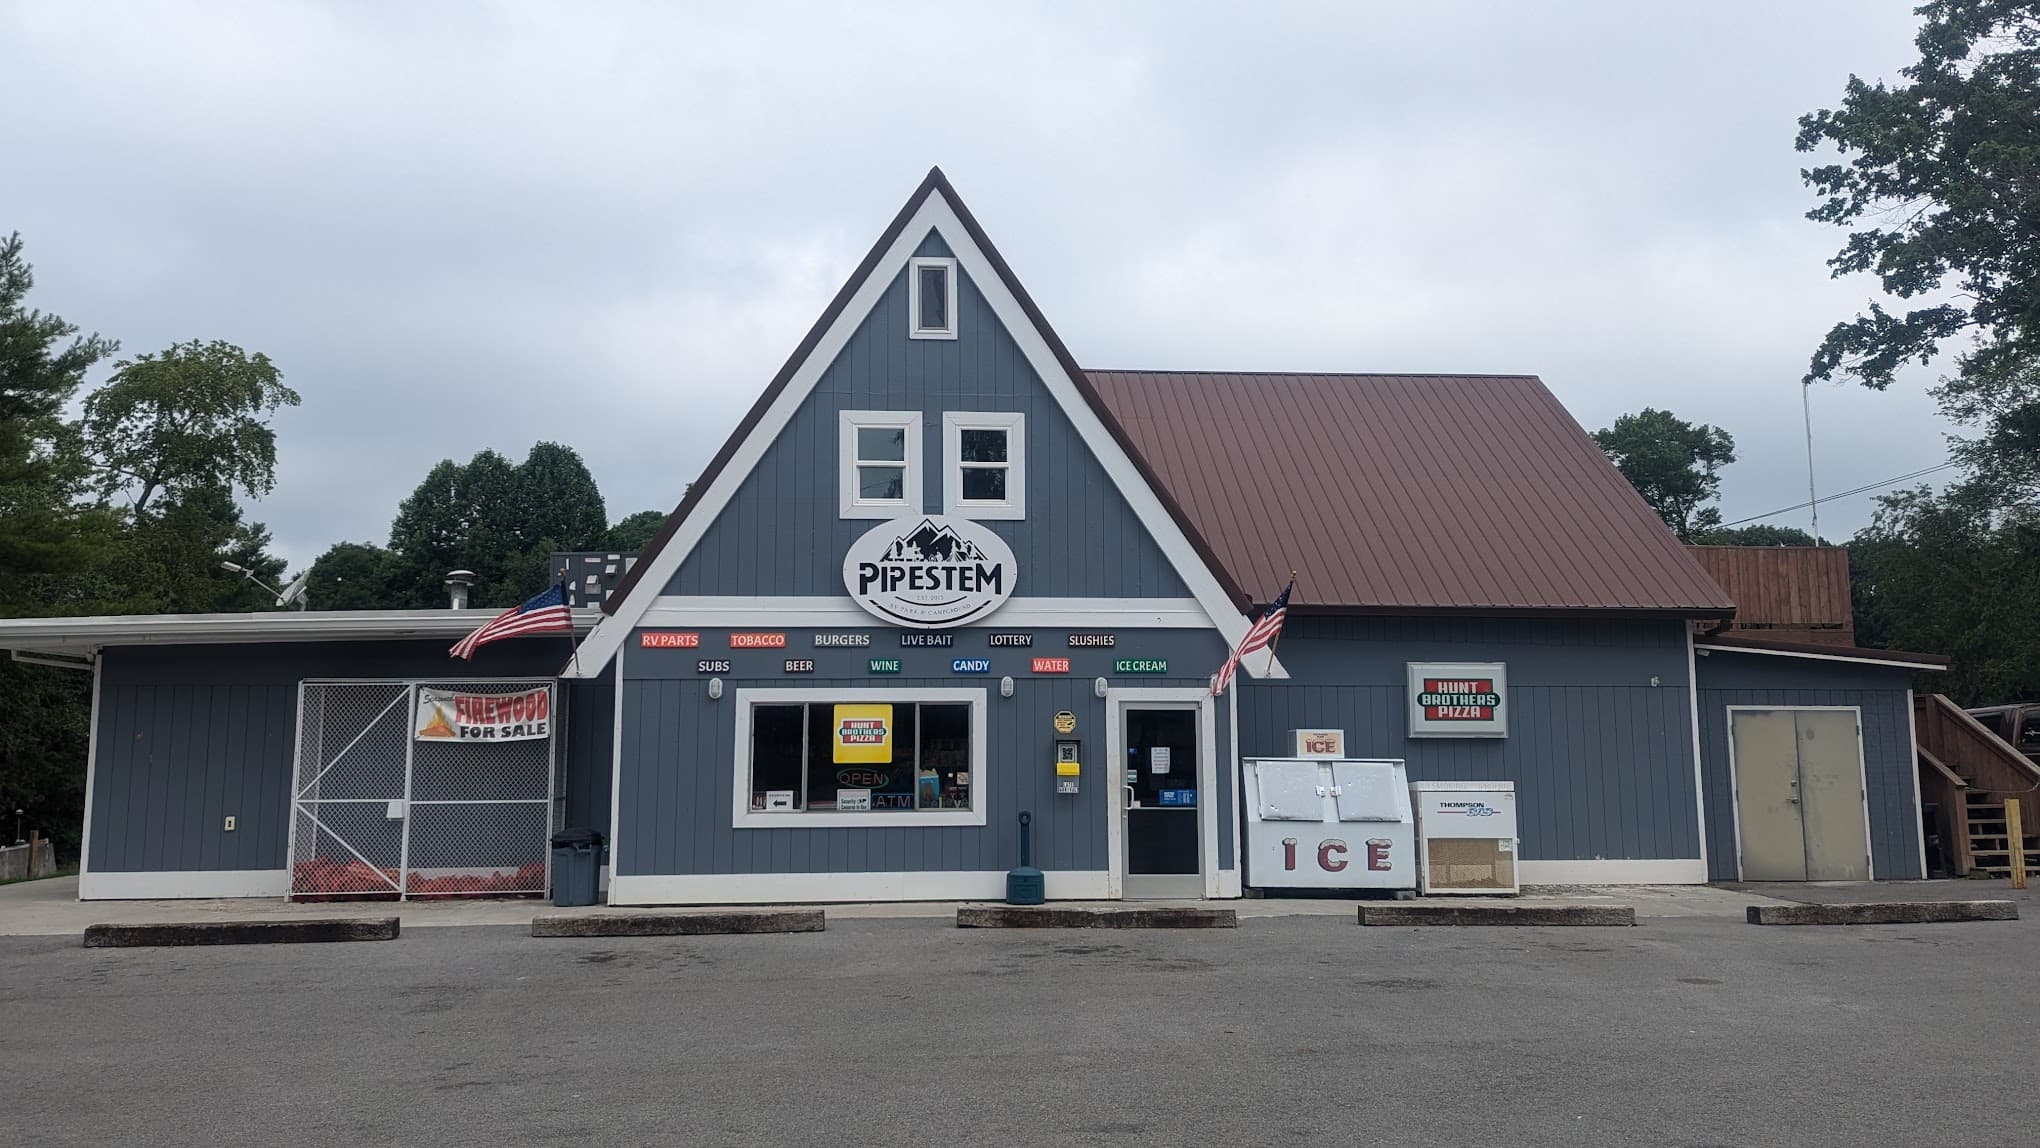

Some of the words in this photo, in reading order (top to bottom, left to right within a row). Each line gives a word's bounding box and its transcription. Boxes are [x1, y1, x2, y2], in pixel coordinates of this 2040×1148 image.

[859, 562, 1002, 596] PIPESTEM
[642, 635, 661, 646] RV
[661, 635, 699, 646] PARTS
[731, 634, 785, 646] TOBACCO
[814, 634, 870, 646] BURGERS
[901, 634, 925, 646] LIVE
[927, 634, 953, 646] BAIT
[990, 634, 1032, 646] LOTTERY
[1069, 635, 1115, 646] SLUSHIES
[698, 660, 730, 672] SUBS
[785, 660, 814, 671] BEER
[870, 660, 899, 671] WINE
[953, 660, 990, 672] CANDY
[1033, 660, 1070, 672] WATER
[1116, 660, 1134, 671] ICE
[1135, 660, 1167, 671] CREAM
[1438, 681, 1478, 693] HUNT
[1421, 694, 1496, 706] BROTHERS
[454, 690, 548, 725] FIREWOOD
[1438, 706, 1480, 718] PIZZA
[460, 725, 496, 738] FOR
[500, 723, 547, 738] SALE
[1305, 738, 1336, 753] ICE
[839, 774, 884, 786] OPEN
[876, 795, 911, 808] ATM
[1466, 807, 1494, 817] GAS
[1282, 837, 1393, 873] ICE
